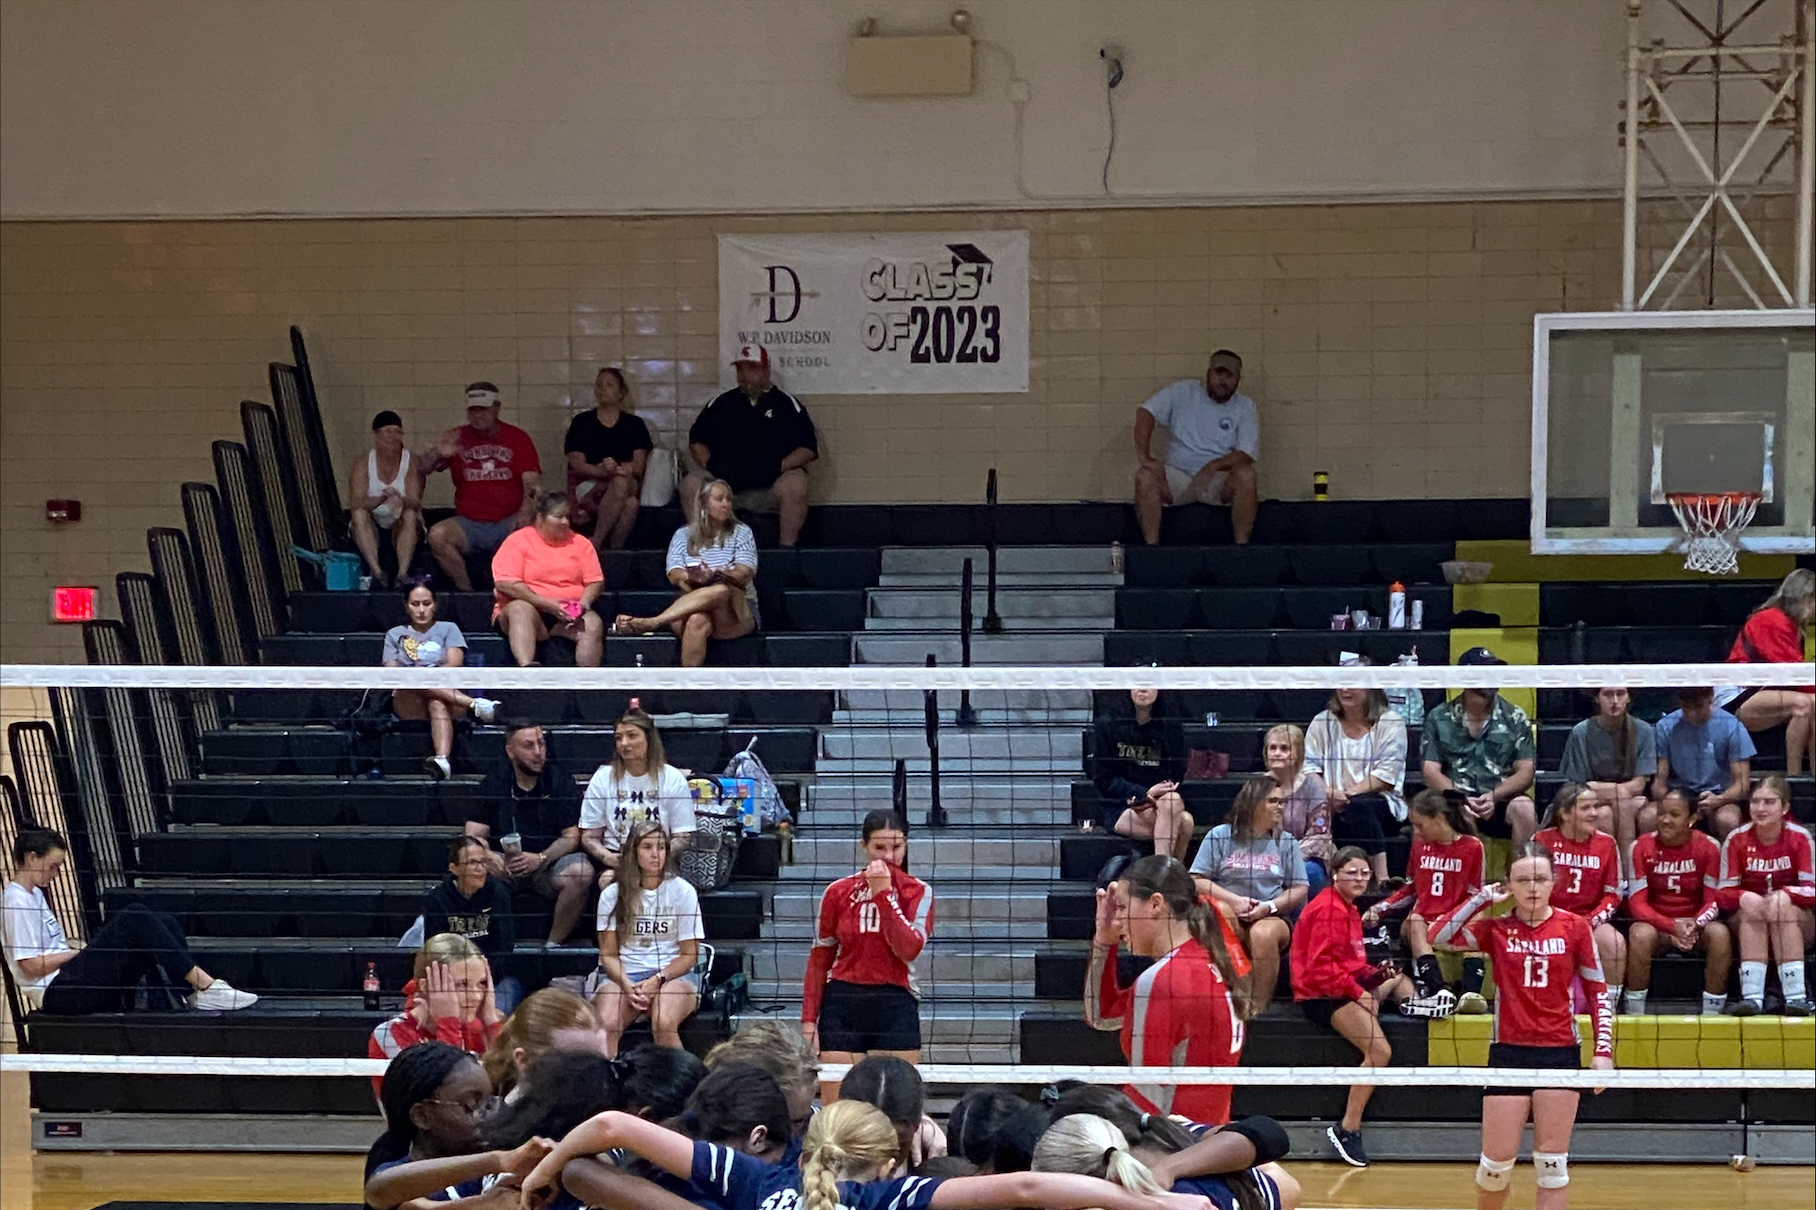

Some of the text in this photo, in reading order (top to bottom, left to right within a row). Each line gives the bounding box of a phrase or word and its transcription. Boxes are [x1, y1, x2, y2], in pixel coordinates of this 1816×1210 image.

[860, 257, 984, 301] CLASS
[763, 265, 801, 324] D
[764, 331, 831, 344] DAVIDSON
[860, 305, 1000, 363] OF 2023
[778, 356, 831, 368] SCHOOL
[1420, 856, 1462, 872] SARALAND
[1553, 851, 1601, 869] SARALAND
[1745, 856, 1792, 872] SARALAND
[1431, 872, 1444, 896] 8
[1567, 868, 1582, 894] 3
[1667, 875, 1681, 895] 5
[1765, 873, 1773, 895] 1
[636, 921, 668, 934] GERS
[859, 902, 880, 933] 10
[1506, 937, 1566, 955] SARALAND
[1523, 955, 1549, 988] 13
[1596, 991, 1613, 1053] SPARTANS
